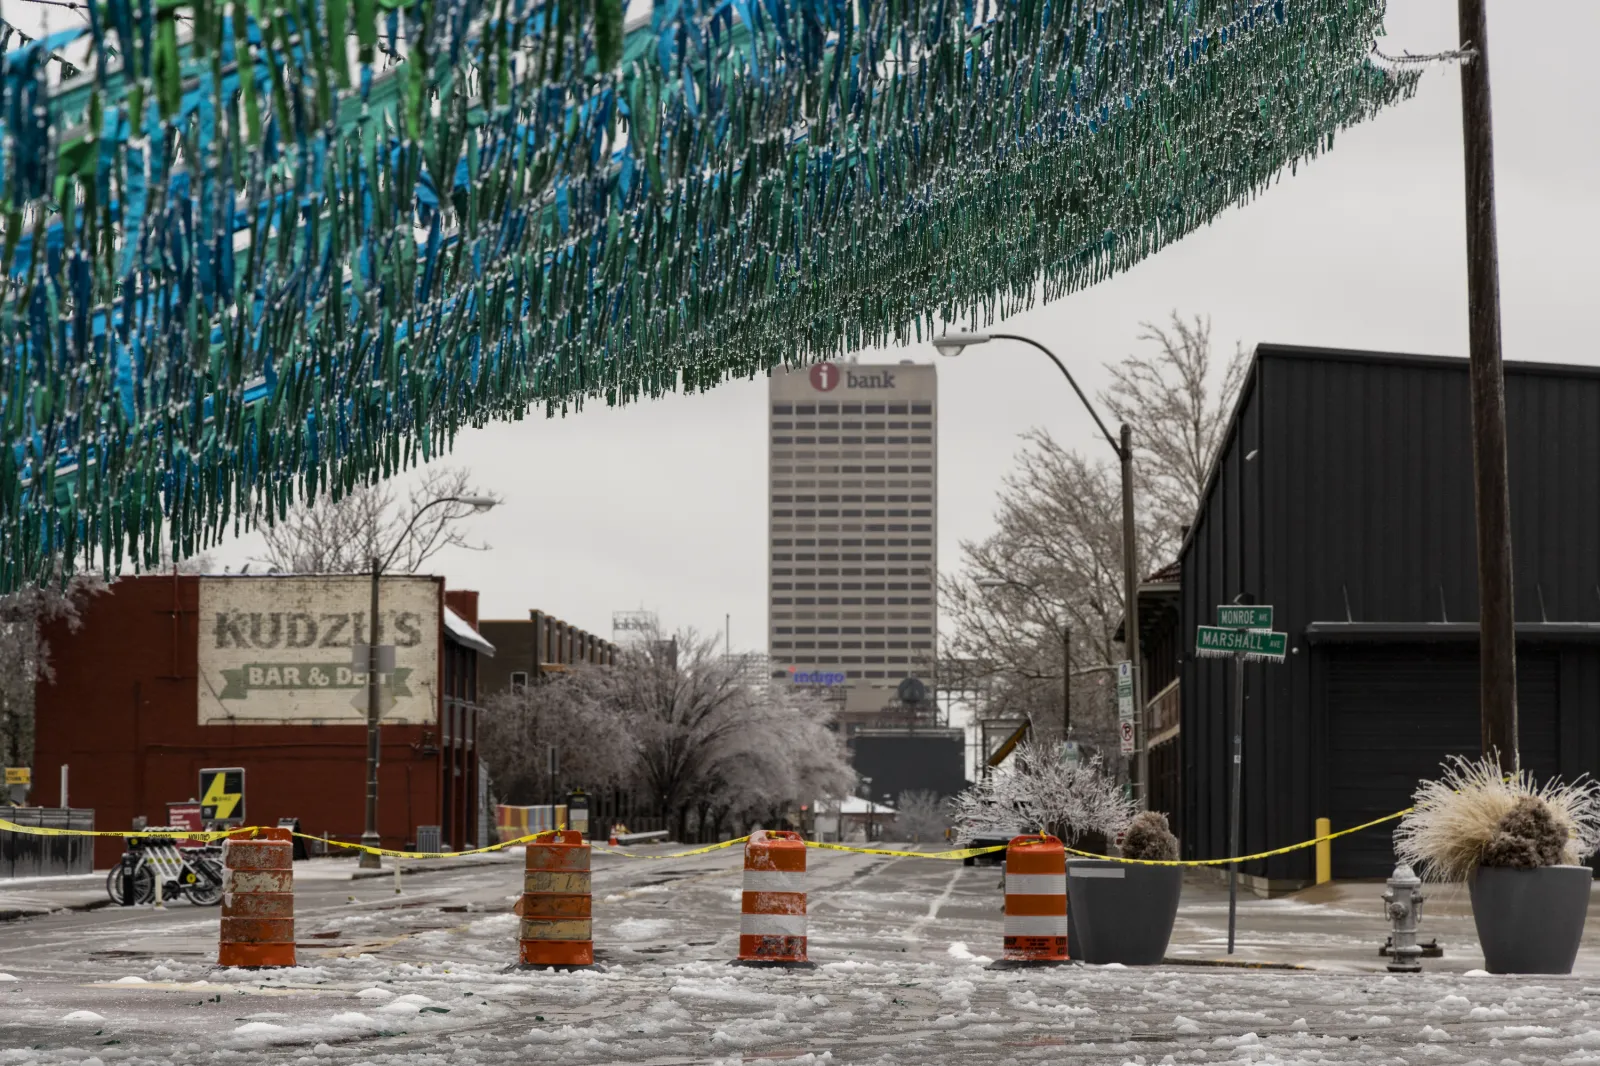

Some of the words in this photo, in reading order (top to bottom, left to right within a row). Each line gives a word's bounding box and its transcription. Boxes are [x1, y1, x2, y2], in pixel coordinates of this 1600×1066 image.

[846, 371, 895, 388] bank
[1221, 610, 1255, 624] MONROE
[213, 611, 421, 648] KUDZU'S
[1202, 631, 1263, 650] MARSHALL
[1270, 640, 1281, 648] AVE
[249, 667, 301, 685] BAR
[308, 667, 329, 686] &
